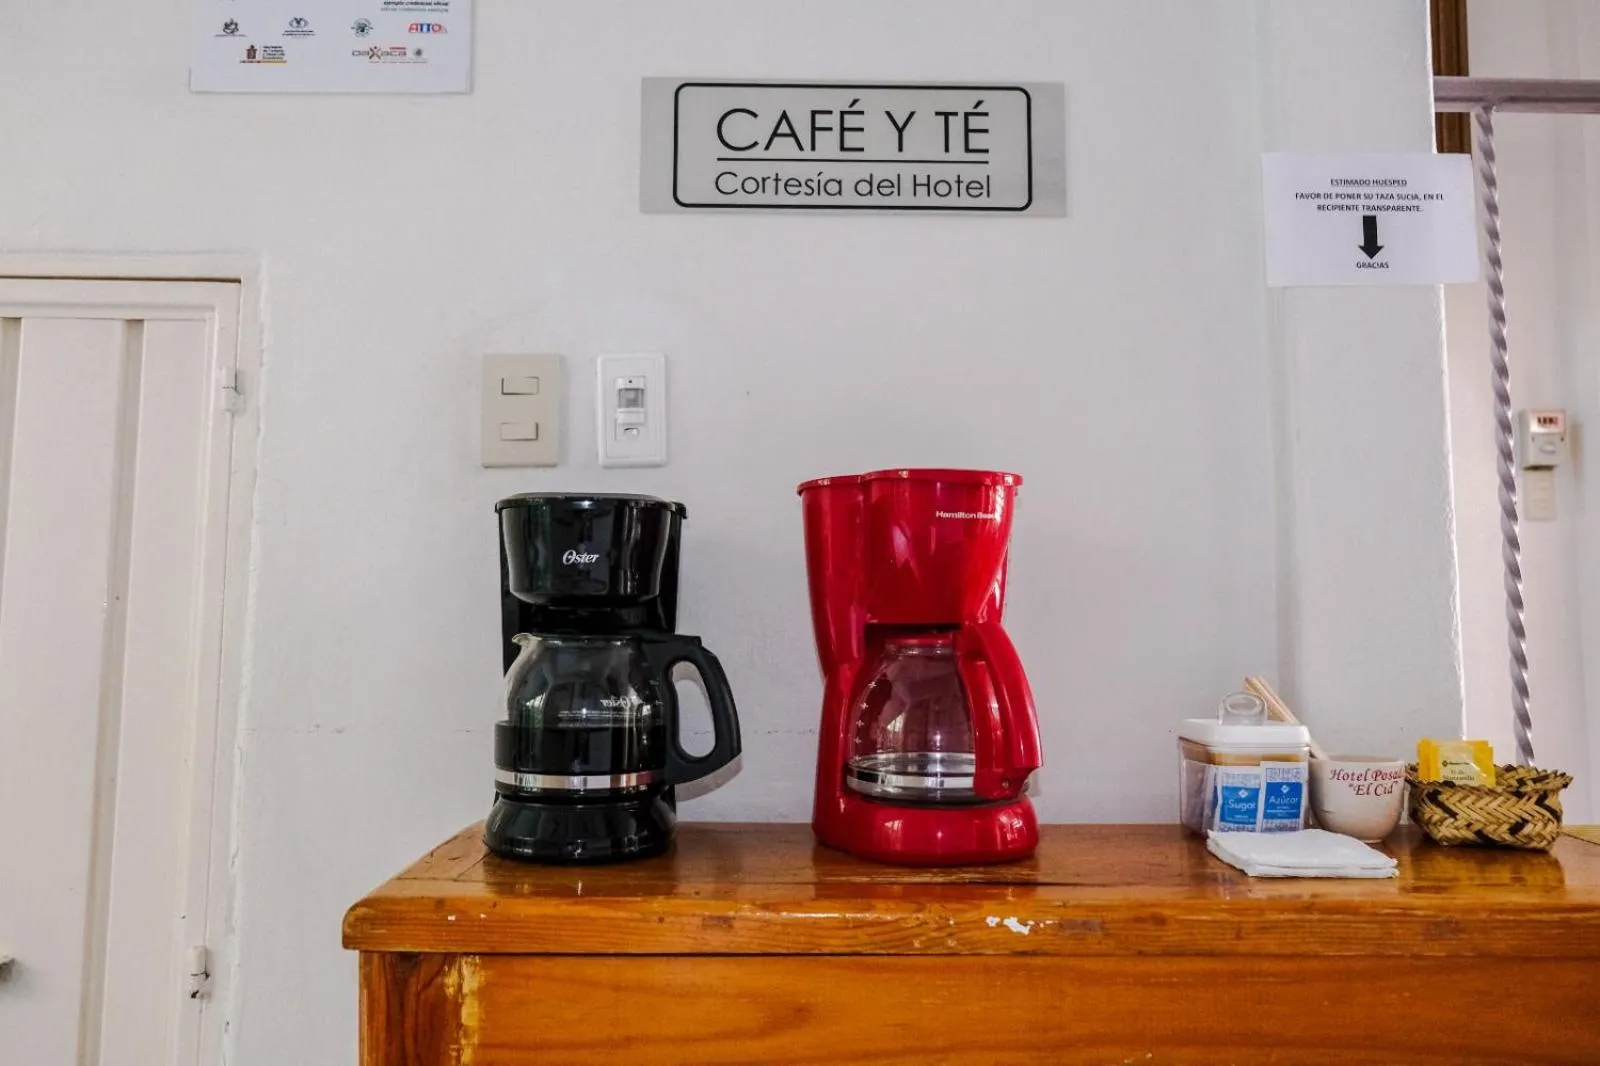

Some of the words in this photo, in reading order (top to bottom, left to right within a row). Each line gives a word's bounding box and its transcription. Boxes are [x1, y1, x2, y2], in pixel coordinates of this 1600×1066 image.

[716, 98, 865, 152] CAFÉ
[884, 110, 916, 153] Y
[934, 100, 990, 154] TÉ
[714, 170, 843, 197] Cortesía
[853, 173, 902, 198] del
[912, 174, 991, 199] Hotel
[1330, 179, 1371, 187] ESTIMADO
[1372, 179, 1408, 187] HUESPED
[1295, 192, 1322, 200] FAVOR
[1323, 192, 1334, 200] DE
[1335, 192, 1362, 200] PONER
[1363, 192, 1374, 200] SU
[1375, 192, 1395, 200] TAZA
[1435, 193, 1445, 201] EL
[1316, 204, 1360, 212] RECIPIENTE
[1356, 261, 1390, 269] GRACIAS
[935, 510, 977, 519] Hamilton
[562, 549, 600, 566] Oster
[1329, 768, 1371, 782] Hotel
[1227, 799, 1257, 811] Sugar
[1268, 794, 1298, 805] Azúcar
